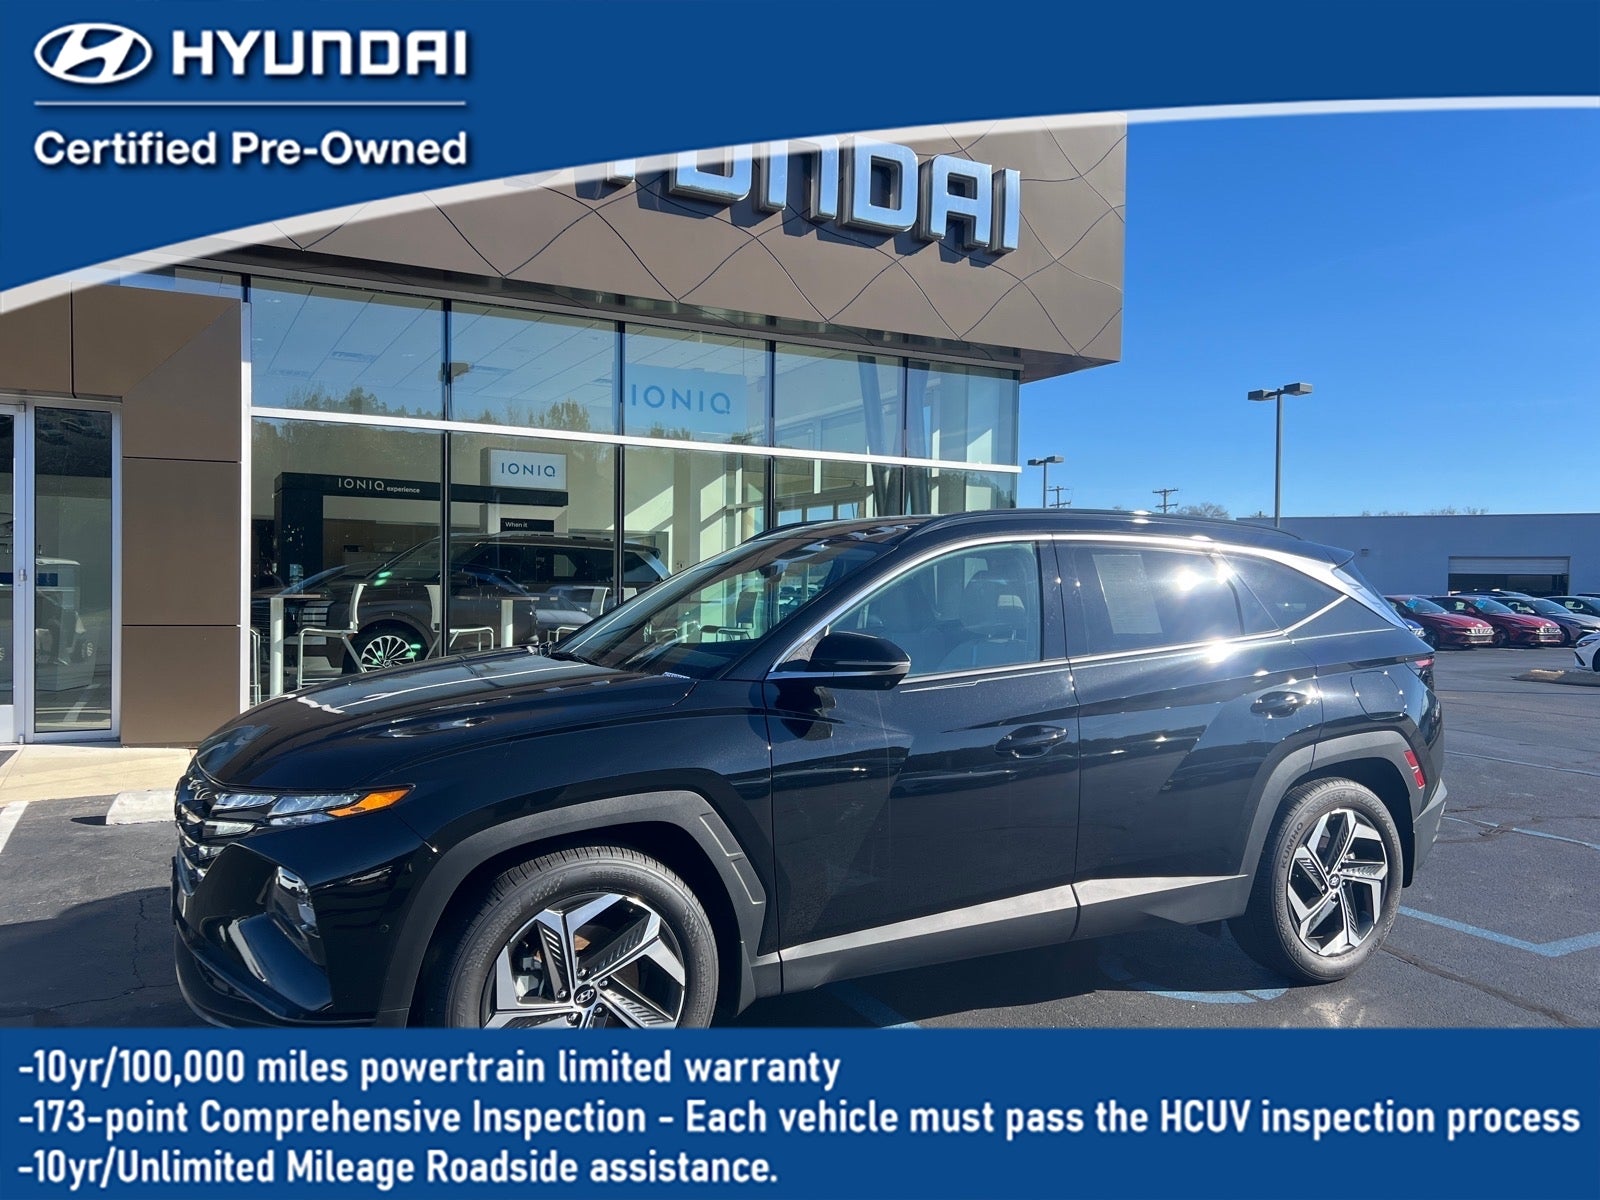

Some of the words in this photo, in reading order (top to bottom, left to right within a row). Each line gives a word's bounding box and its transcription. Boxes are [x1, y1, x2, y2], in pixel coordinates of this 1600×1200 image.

[604, 134, 1021, 252] UNDAI
[631, 384, 731, 415] IONIQ
[501, 462, 556, 478] IONIQ
[338, 477, 385, 491] IONIQ
[386, 486, 421, 494] experience
[504, 521, 522, 529] When
[1281, 822, 1304, 869] KUMHO
